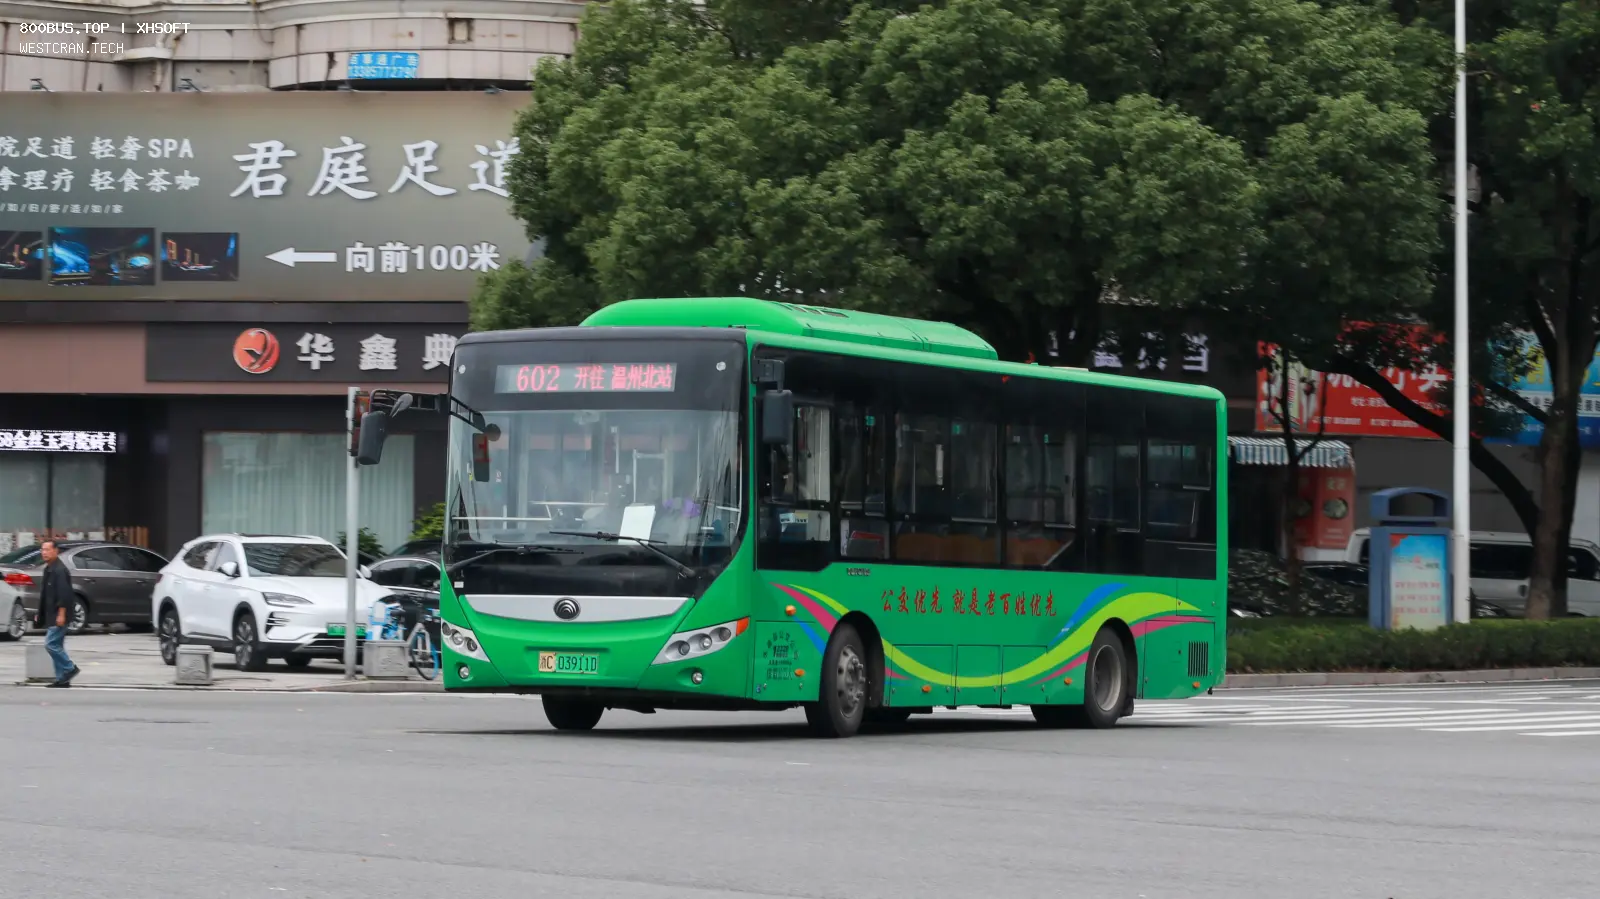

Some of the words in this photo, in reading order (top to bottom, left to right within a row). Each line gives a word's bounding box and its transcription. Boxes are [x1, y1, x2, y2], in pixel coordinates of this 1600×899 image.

[89, 168, 200, 193] 轻食茶咖
[229, 136, 520, 200] 君庭足道
[345, 242, 500, 273] 向前100米
[296, 332, 459, 371] 华鑫典
[516, 365, 561, 392] 602
[574, 366, 606, 390] 开往
[611, 364, 673, 390] 温州北站
[881, 585, 943, 614] 公交优先
[952, 587, 1057, 616] 就是老百姓优先
[558, 655, 597, 672] 03911D
